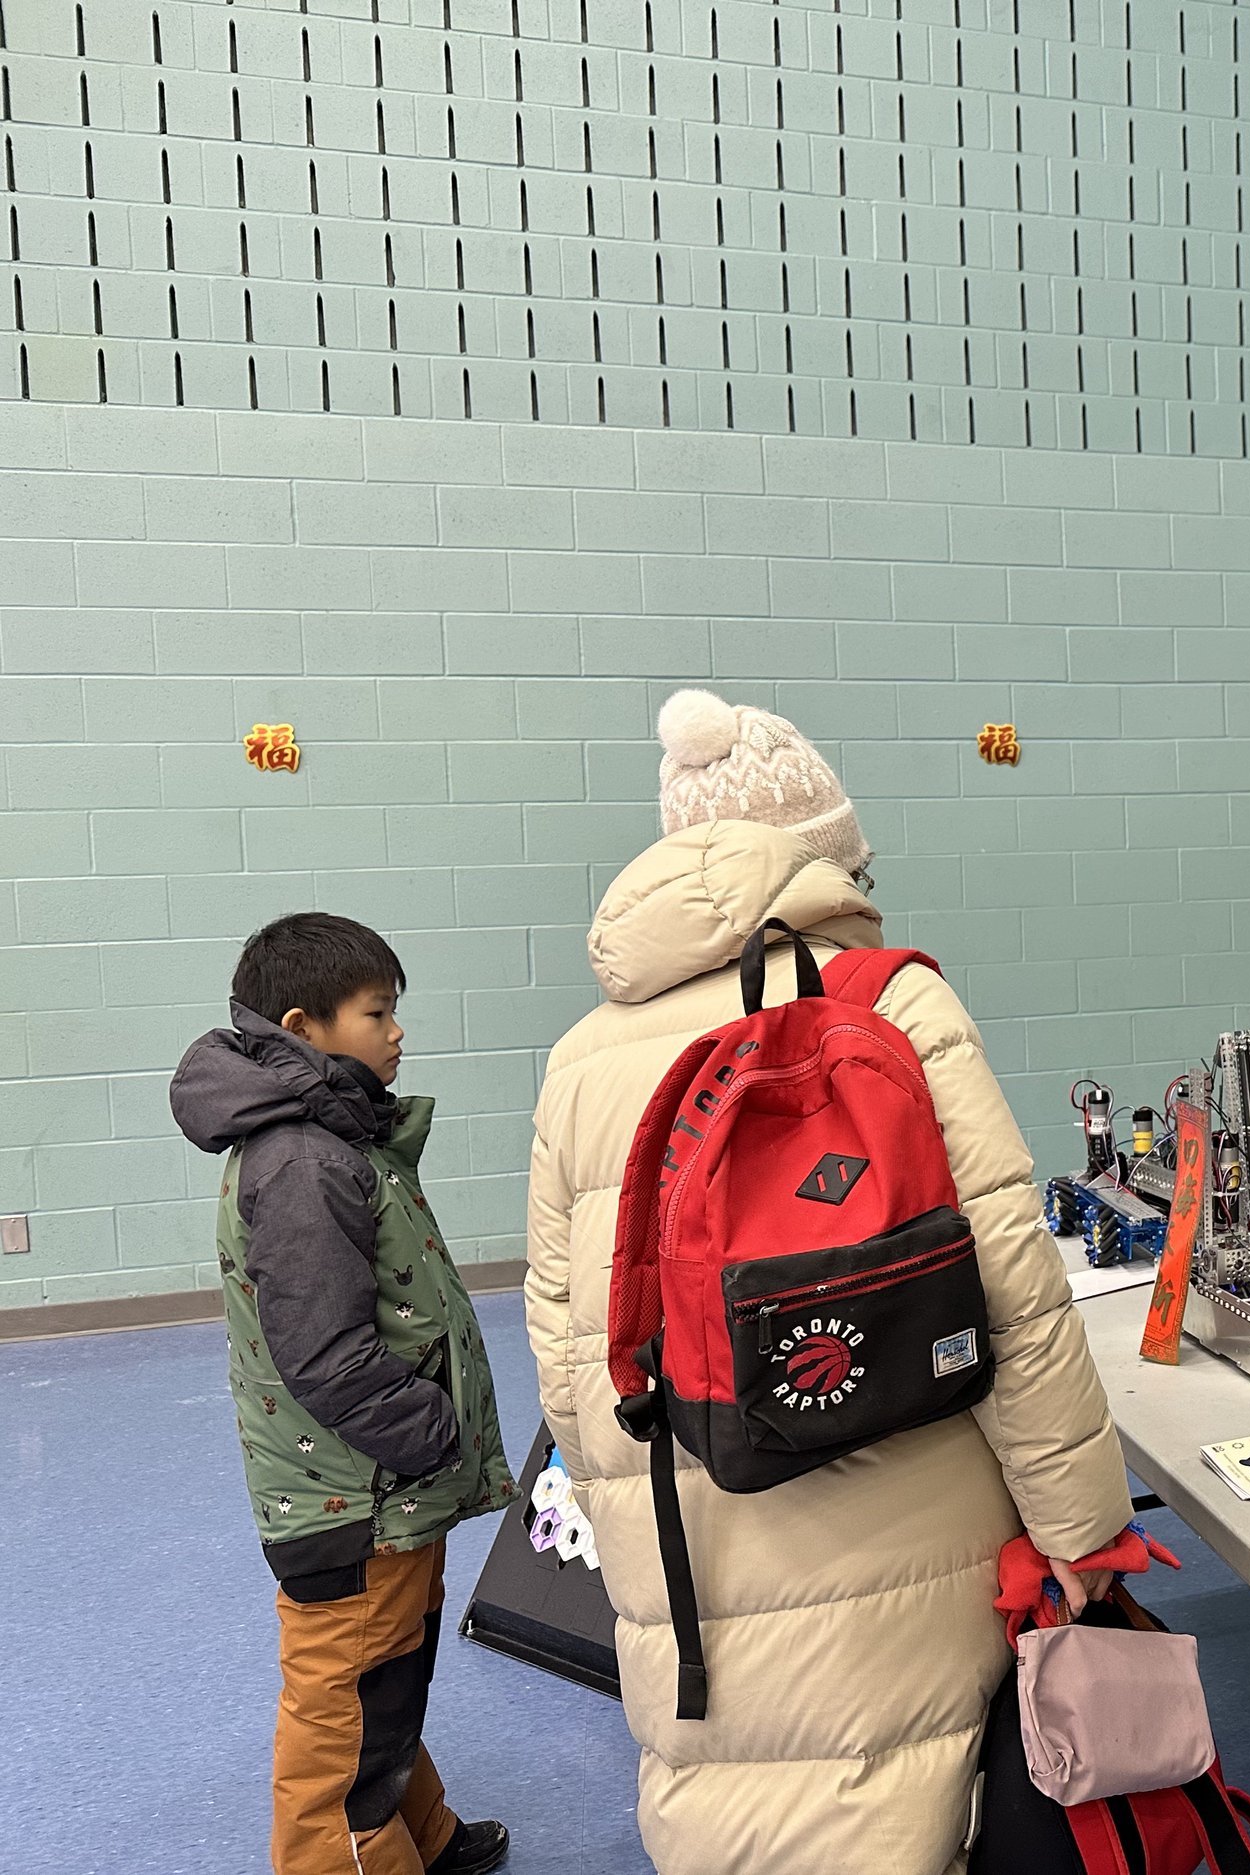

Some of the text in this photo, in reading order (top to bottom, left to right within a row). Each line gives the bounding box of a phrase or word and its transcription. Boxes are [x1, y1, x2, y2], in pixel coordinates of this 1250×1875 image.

[244, 724, 299, 773] 福
[977, 723, 1020, 766] 福
[770, 1318, 865, 1363] TORONTO
[772, 1366, 865, 1411] RAPTORS
